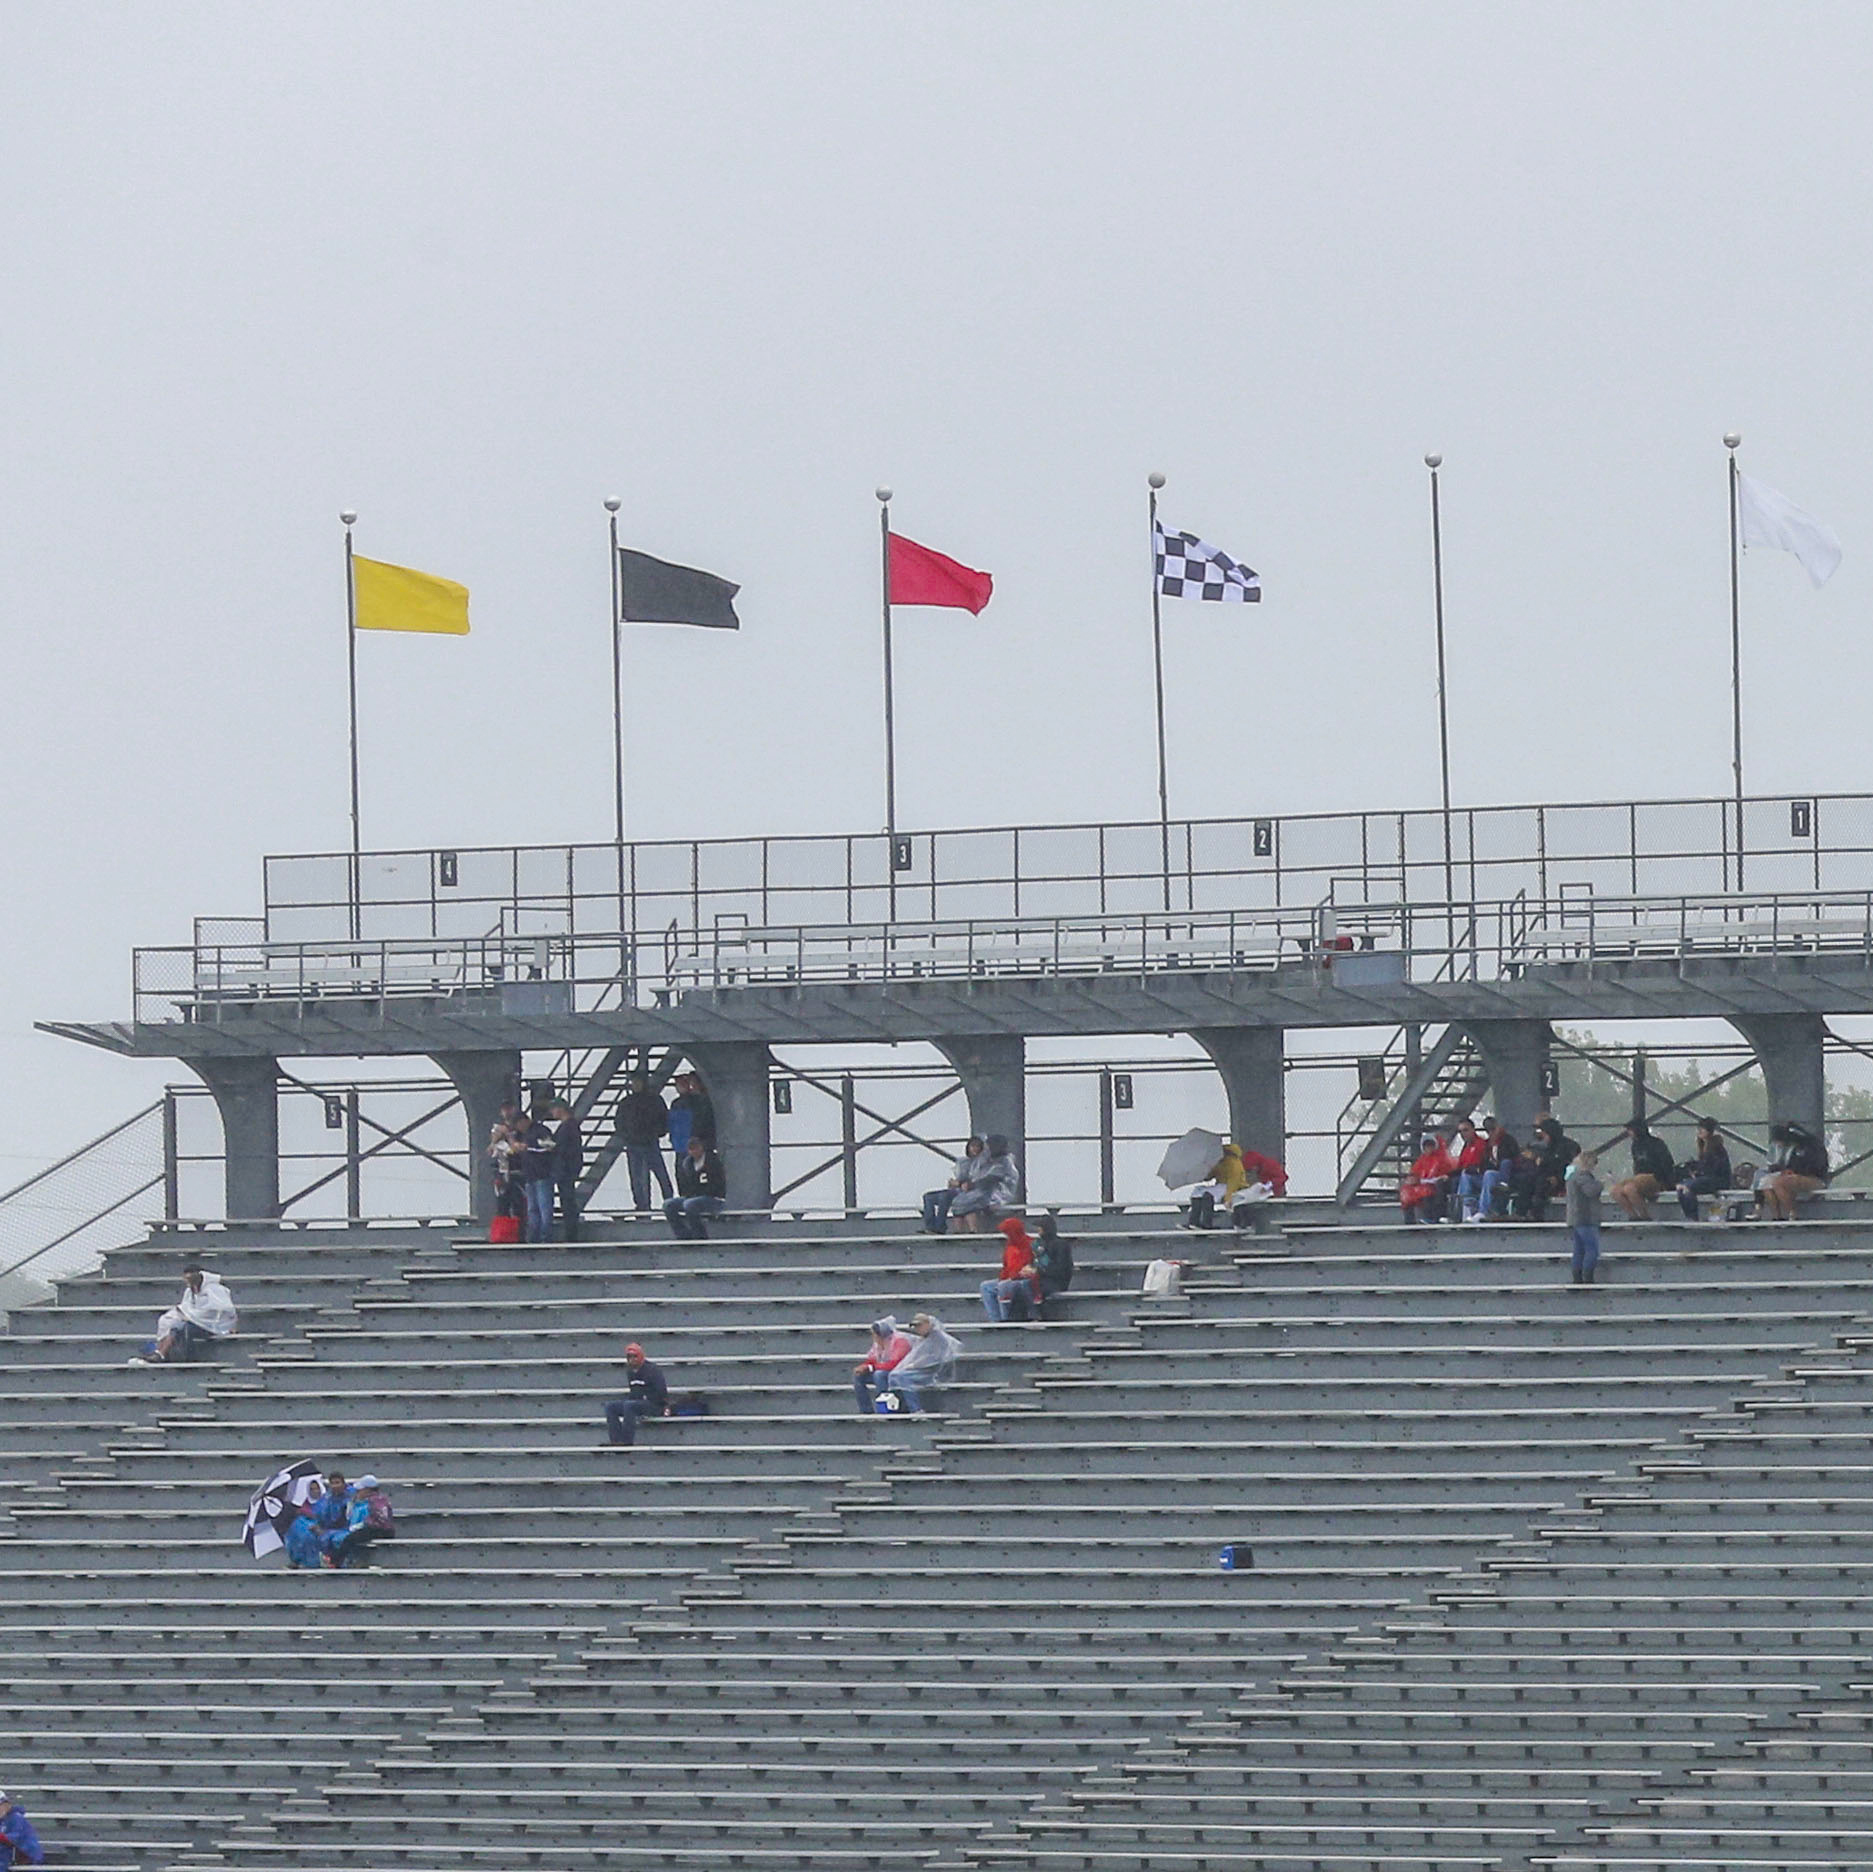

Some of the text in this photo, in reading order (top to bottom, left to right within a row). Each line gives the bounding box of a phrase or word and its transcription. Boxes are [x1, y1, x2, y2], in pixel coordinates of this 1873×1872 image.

[1798, 810, 1803, 829] 1
[1259, 830, 1267, 848] 2
[900, 845, 907, 863] 3
[446, 861, 452, 879] 4
[1545, 1071, 1553, 1089] 2
[1120, 1083, 1127, 1101] 3
[330, 1104, 337, 1120] 5
